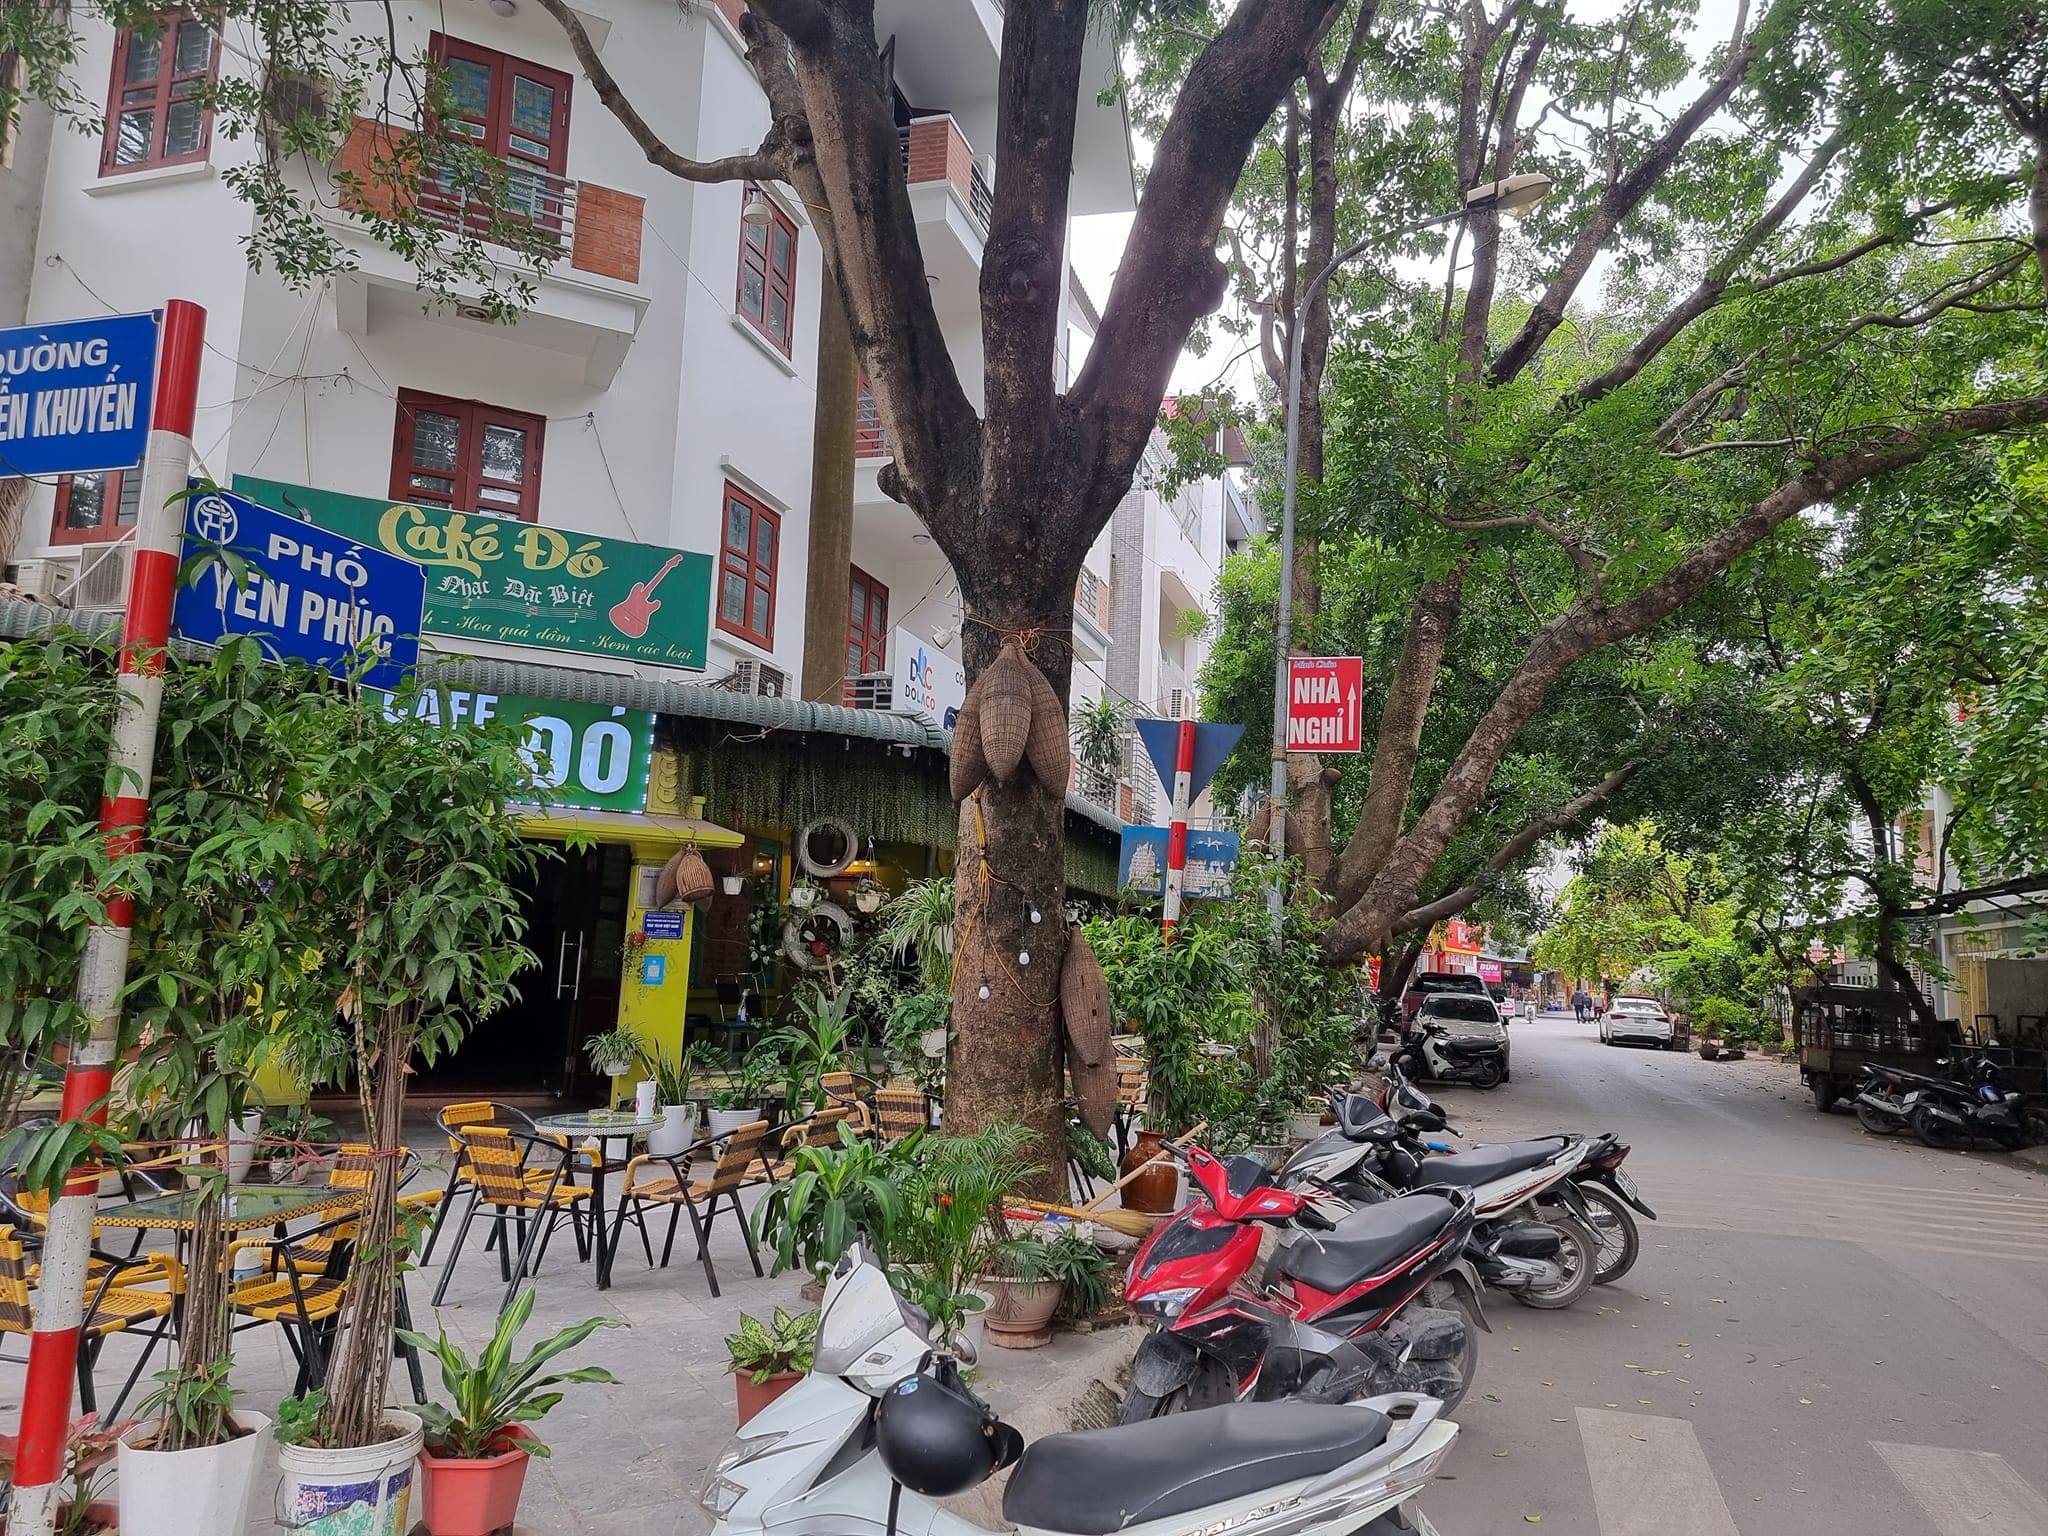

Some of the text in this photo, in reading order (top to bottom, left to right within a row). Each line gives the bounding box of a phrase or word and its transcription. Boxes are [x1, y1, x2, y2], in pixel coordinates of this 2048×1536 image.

[0, 334, 109, 375] ƯỜNG
[33, 364, 137, 437] KHUYẾN
[268, 533, 368, 588] PHỐ
[378, 505, 610, 579] Café Đó
[436, 575, 491, 600] Nhạc
[547, 583, 595, 609] Biệt
[299, 590, 395, 657] PHÚC
[456, 615, 492, 632] Hoa
[592, 634, 630, 652] Kem
[636, 642, 660, 656] các
[665, 643, 693, 663] loại
[1294, 671, 1341, 704] NHÀ
[1289, 707, 1344, 744] NGHỈ
